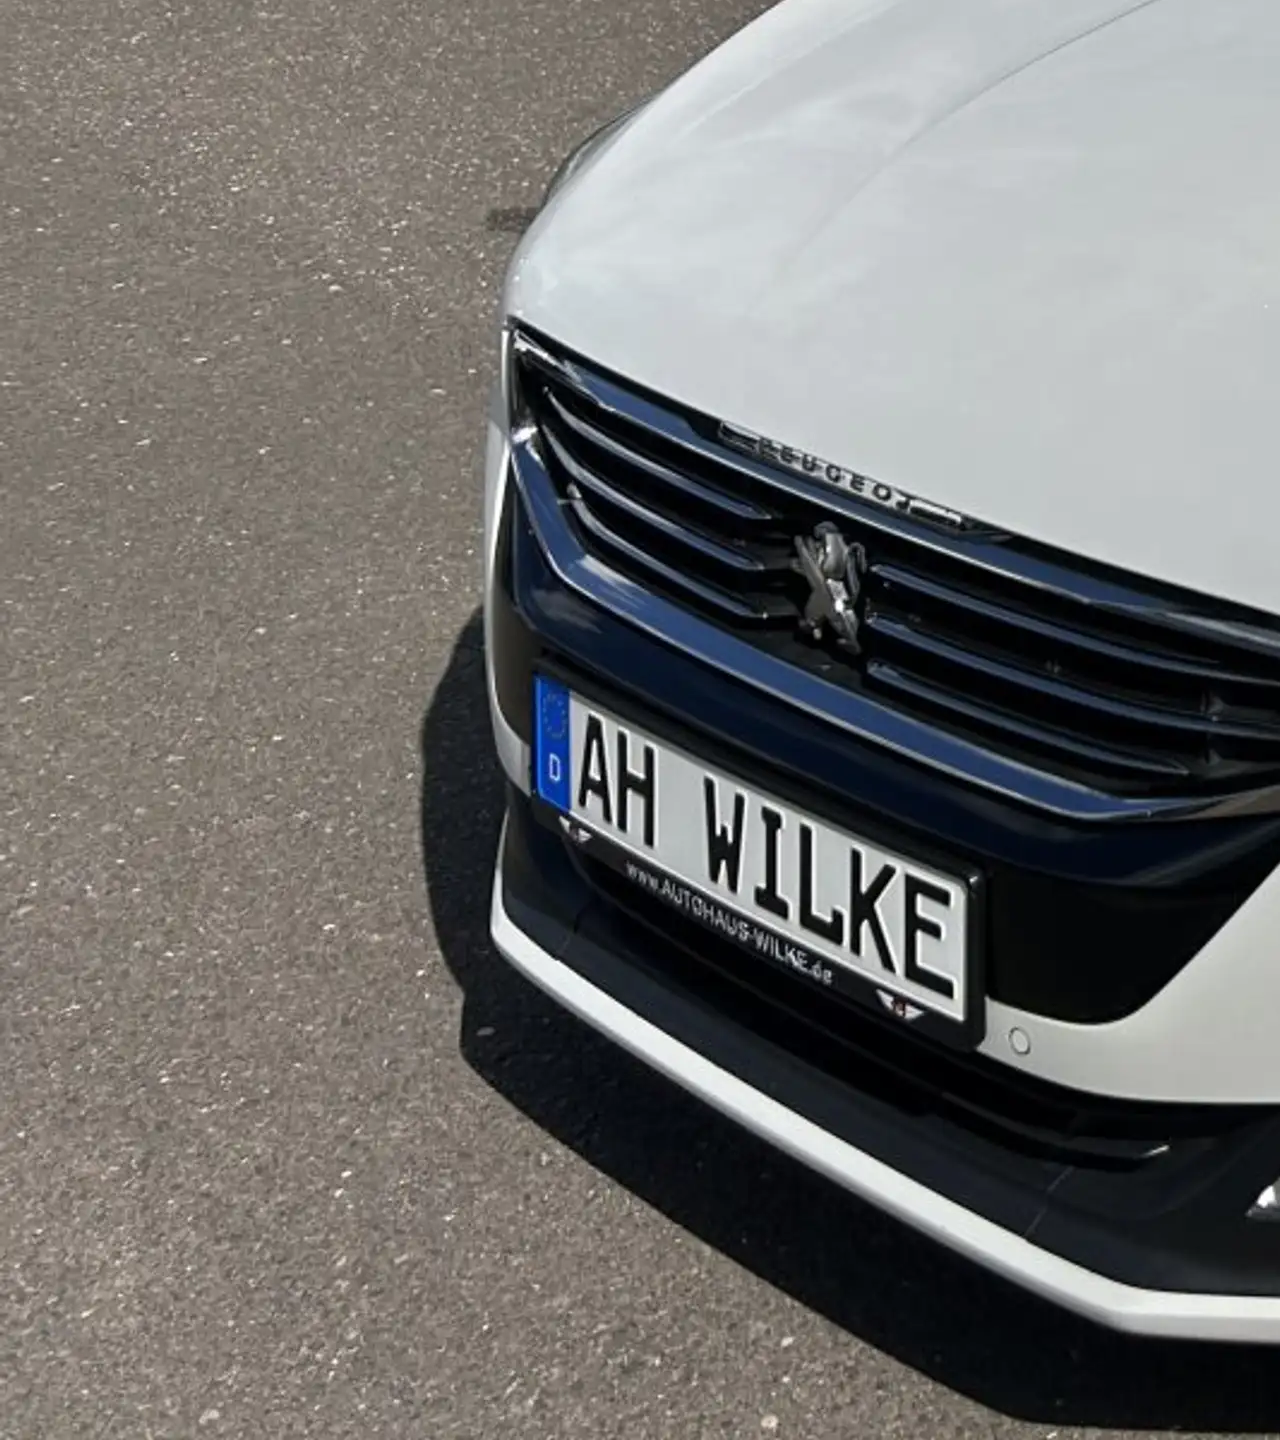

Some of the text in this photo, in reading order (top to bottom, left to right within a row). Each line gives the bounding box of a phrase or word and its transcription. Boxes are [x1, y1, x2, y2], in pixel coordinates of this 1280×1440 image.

[549, 752, 561, 782] D
[578, 713, 955, 1000] AH WILKE
[626, 861, 833, 984] www.AUTOHAUS-WILKE.de
